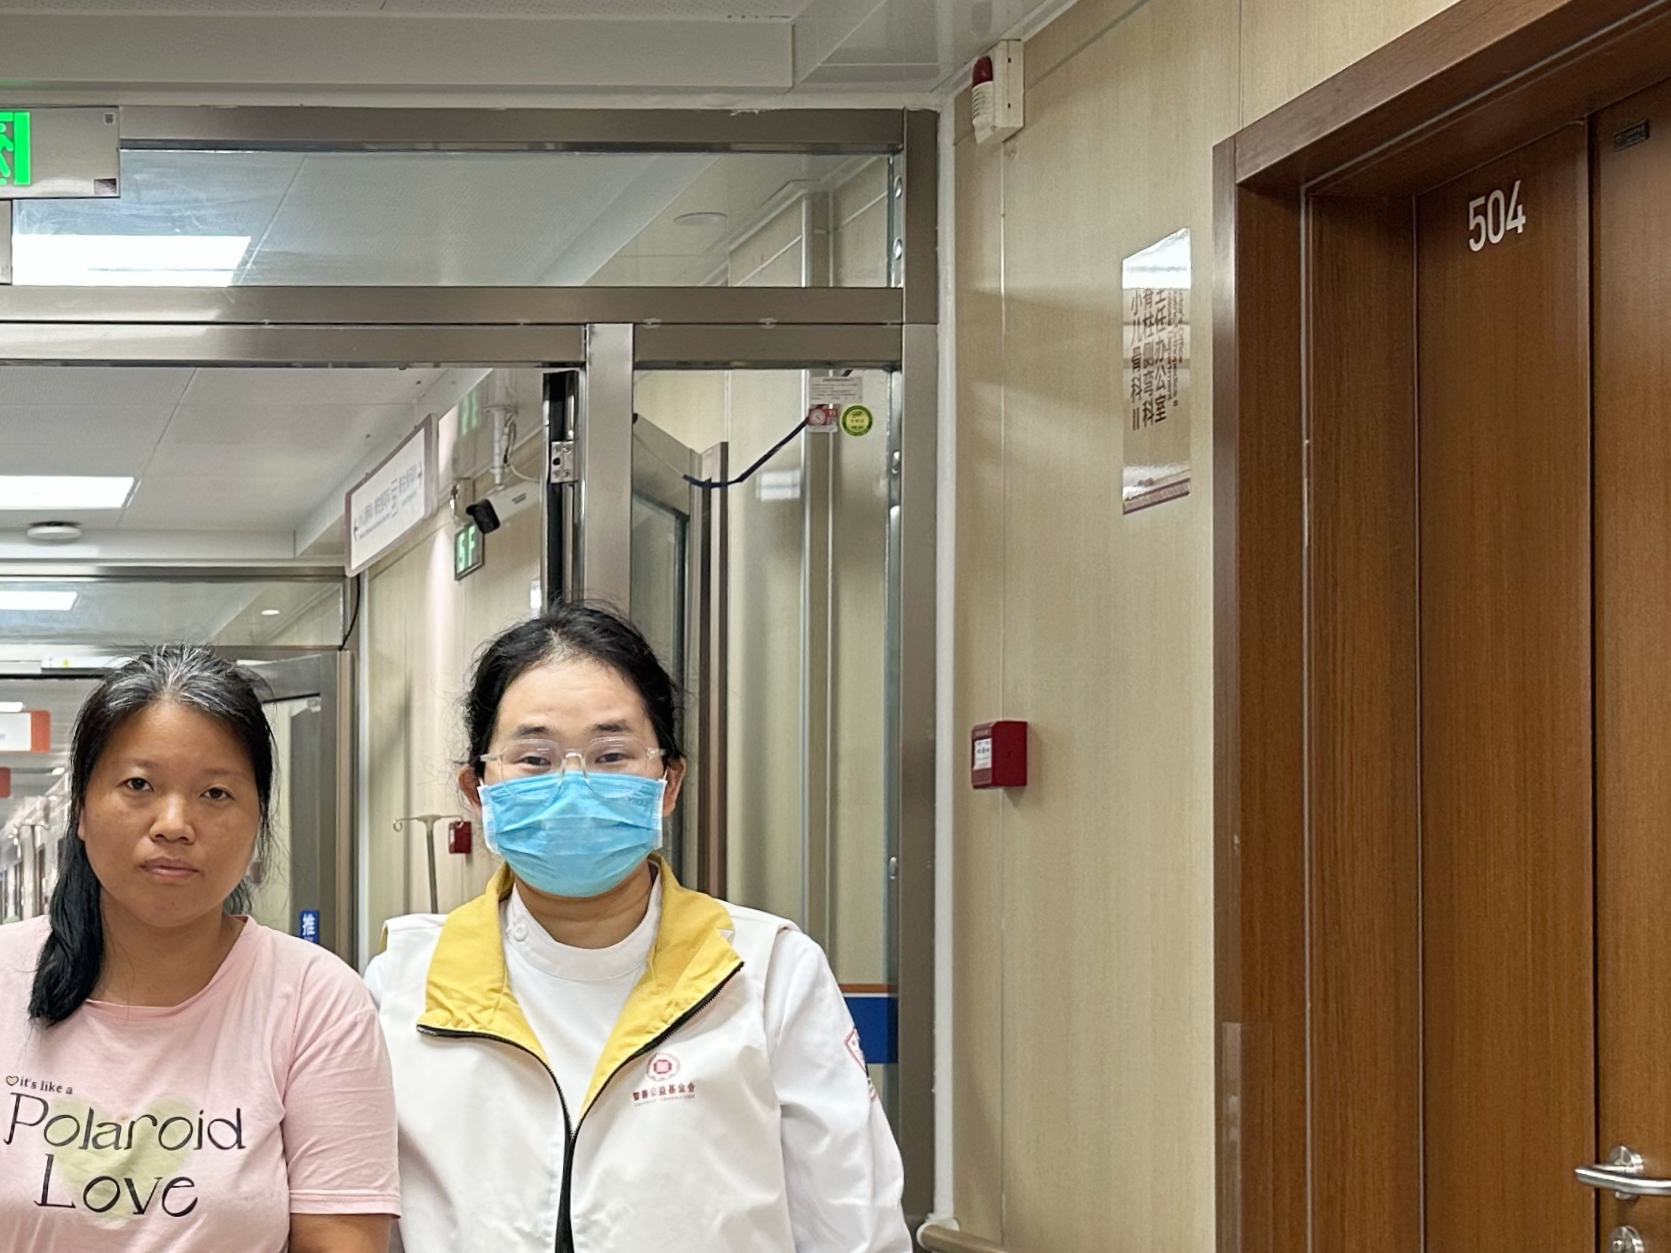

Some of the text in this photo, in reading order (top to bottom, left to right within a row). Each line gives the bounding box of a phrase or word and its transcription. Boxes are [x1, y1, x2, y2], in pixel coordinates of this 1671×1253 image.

[1468, 179, 1527, 252] 504
[456, 525, 476, 575] 5F
[302, 913, 316, 936] 推
[19, 1076, 74, 1095] it's like a
[3, 1092, 247, 1151] Polaroid
[33, 1153, 199, 1218] Love
